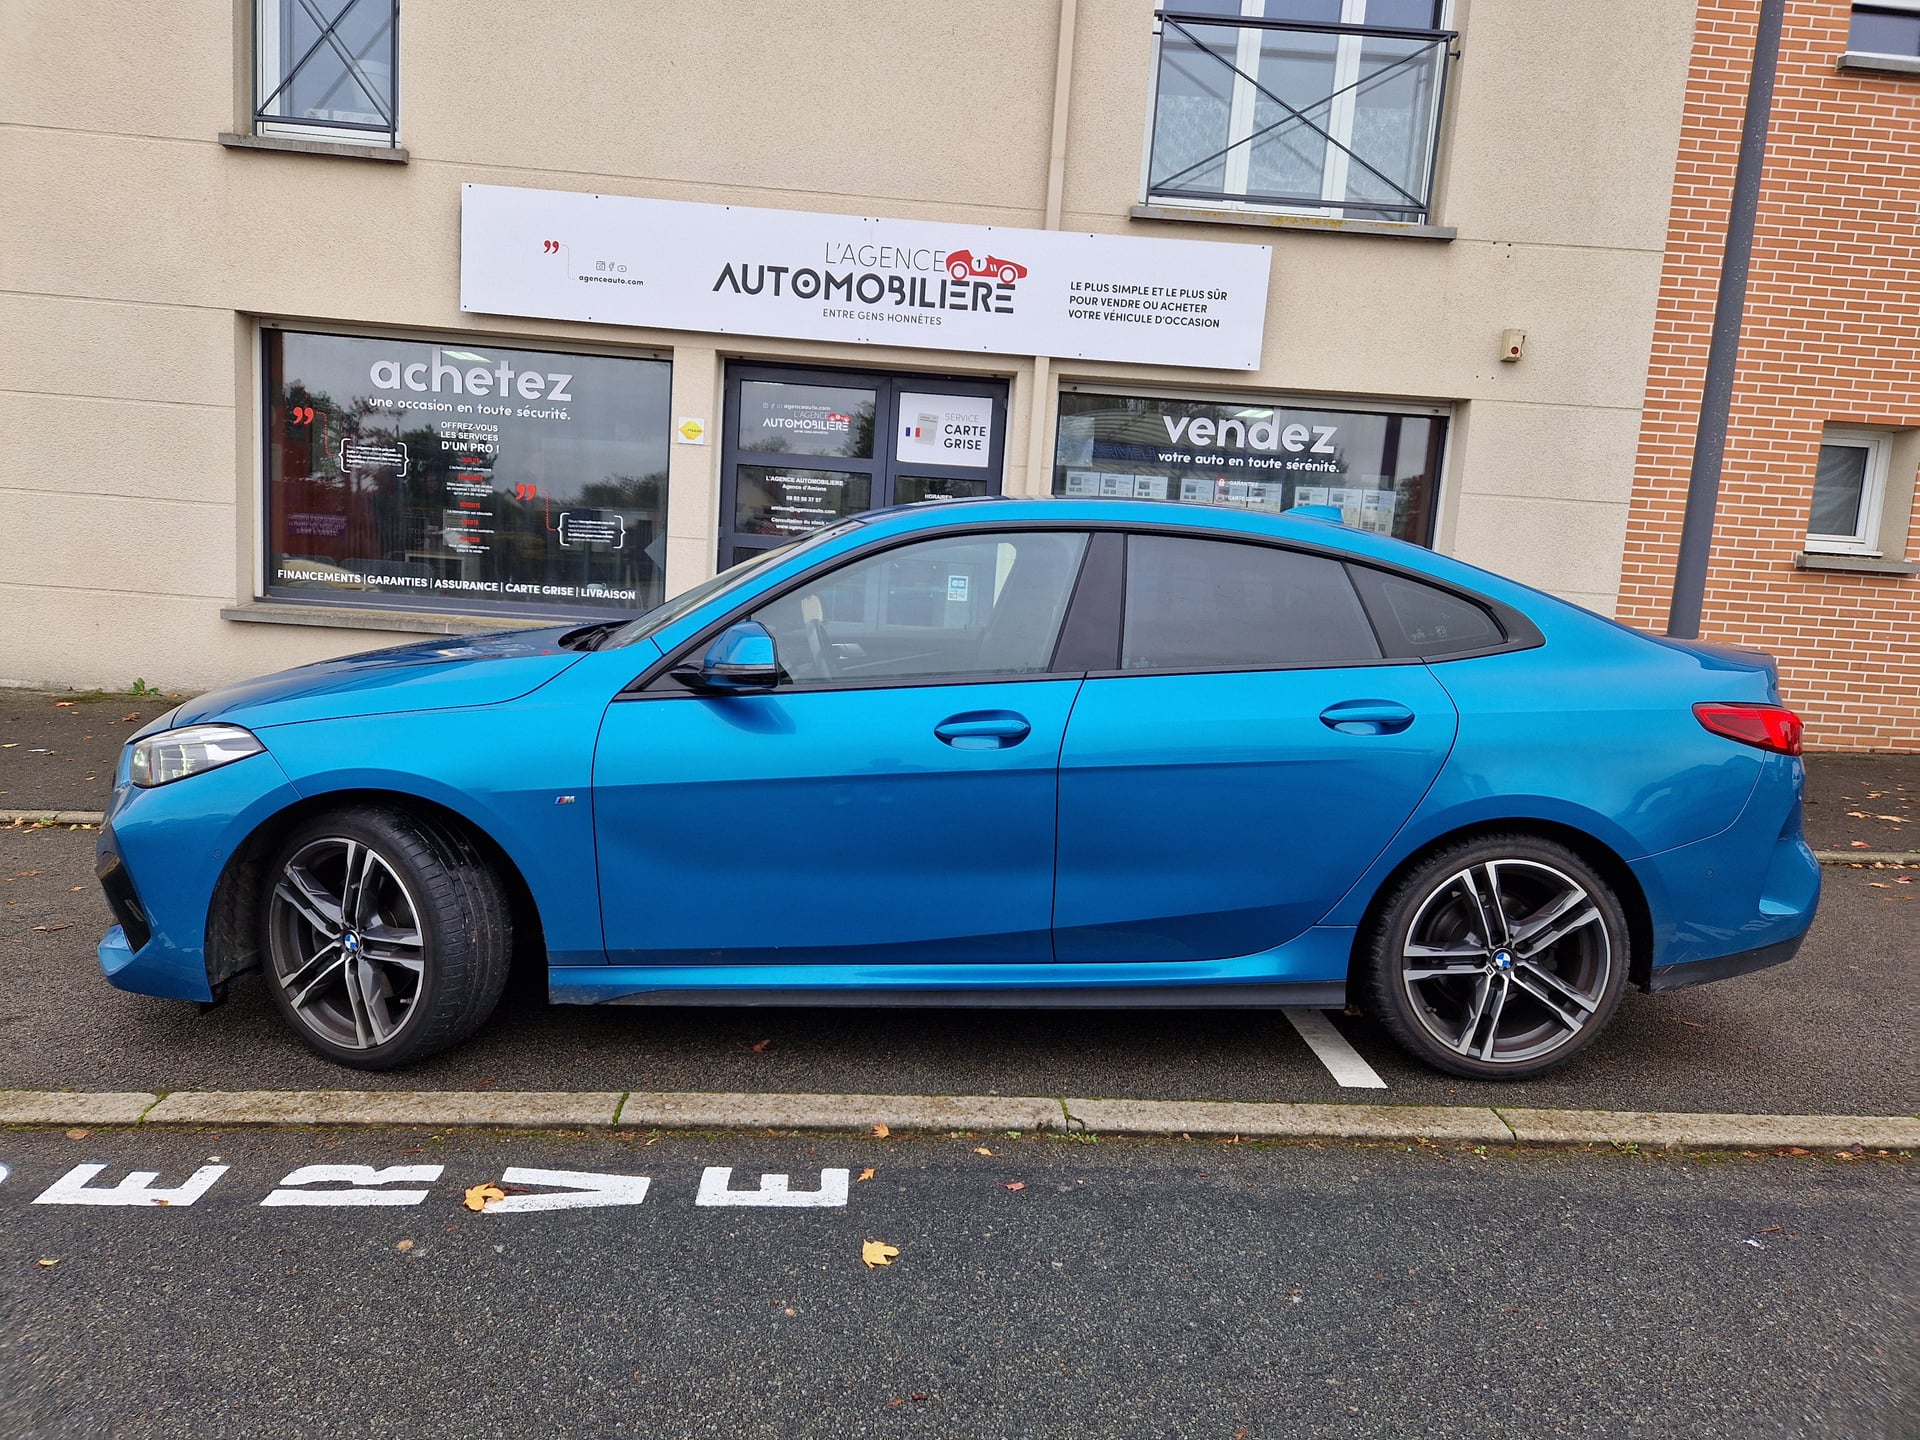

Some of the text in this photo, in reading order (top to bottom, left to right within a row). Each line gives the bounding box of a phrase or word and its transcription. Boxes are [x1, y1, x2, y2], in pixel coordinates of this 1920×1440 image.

[825, 242, 946, 272] L'AGENCE
[976, 259, 981, 268] 1
[579, 275, 643, 286] agenceauto.com
[1070, 281, 1228, 300] LE PLUS SIMPLE ET LE PLUS SÛR
[1069, 295, 1207, 313] POUR VENDRE OU ACHETER
[823, 309, 942, 325] ENTRE GENS HONNÊTES
[1068, 309, 1220, 328] VOTRE VÉHICULE D'OCCASION
[370, 347, 573, 402] achetez
[369, 398, 571, 421] une occasion en toute sécurité.
[945, 413, 980, 423] SERVICE
[441, 421, 498, 432] OFFREZ-VOUS
[944, 424, 987, 437] CARTE
[1162, 408, 1338, 454] vendez
[440, 431, 498, 442] LES SERVICES
[441, 441, 468, 451] D'UN
[470, 443, 493, 453] PRO
[943, 438, 982, 450] GRISE
[1158, 452, 1191, 463] votre
[1195, 455, 1225, 466] auto
[1228, 457, 1244, 467] en
[1249, 457, 1282, 469] toute
[1286, 458, 1340, 473] sérénité.
[765, 475, 795, 483] L'AGENCE
[782, 483, 802, 491] Agence
[277, 569, 636, 600] FINANCEMENTS GARANTIES ASSURANCE CARTE GRISE LIVRAISON
